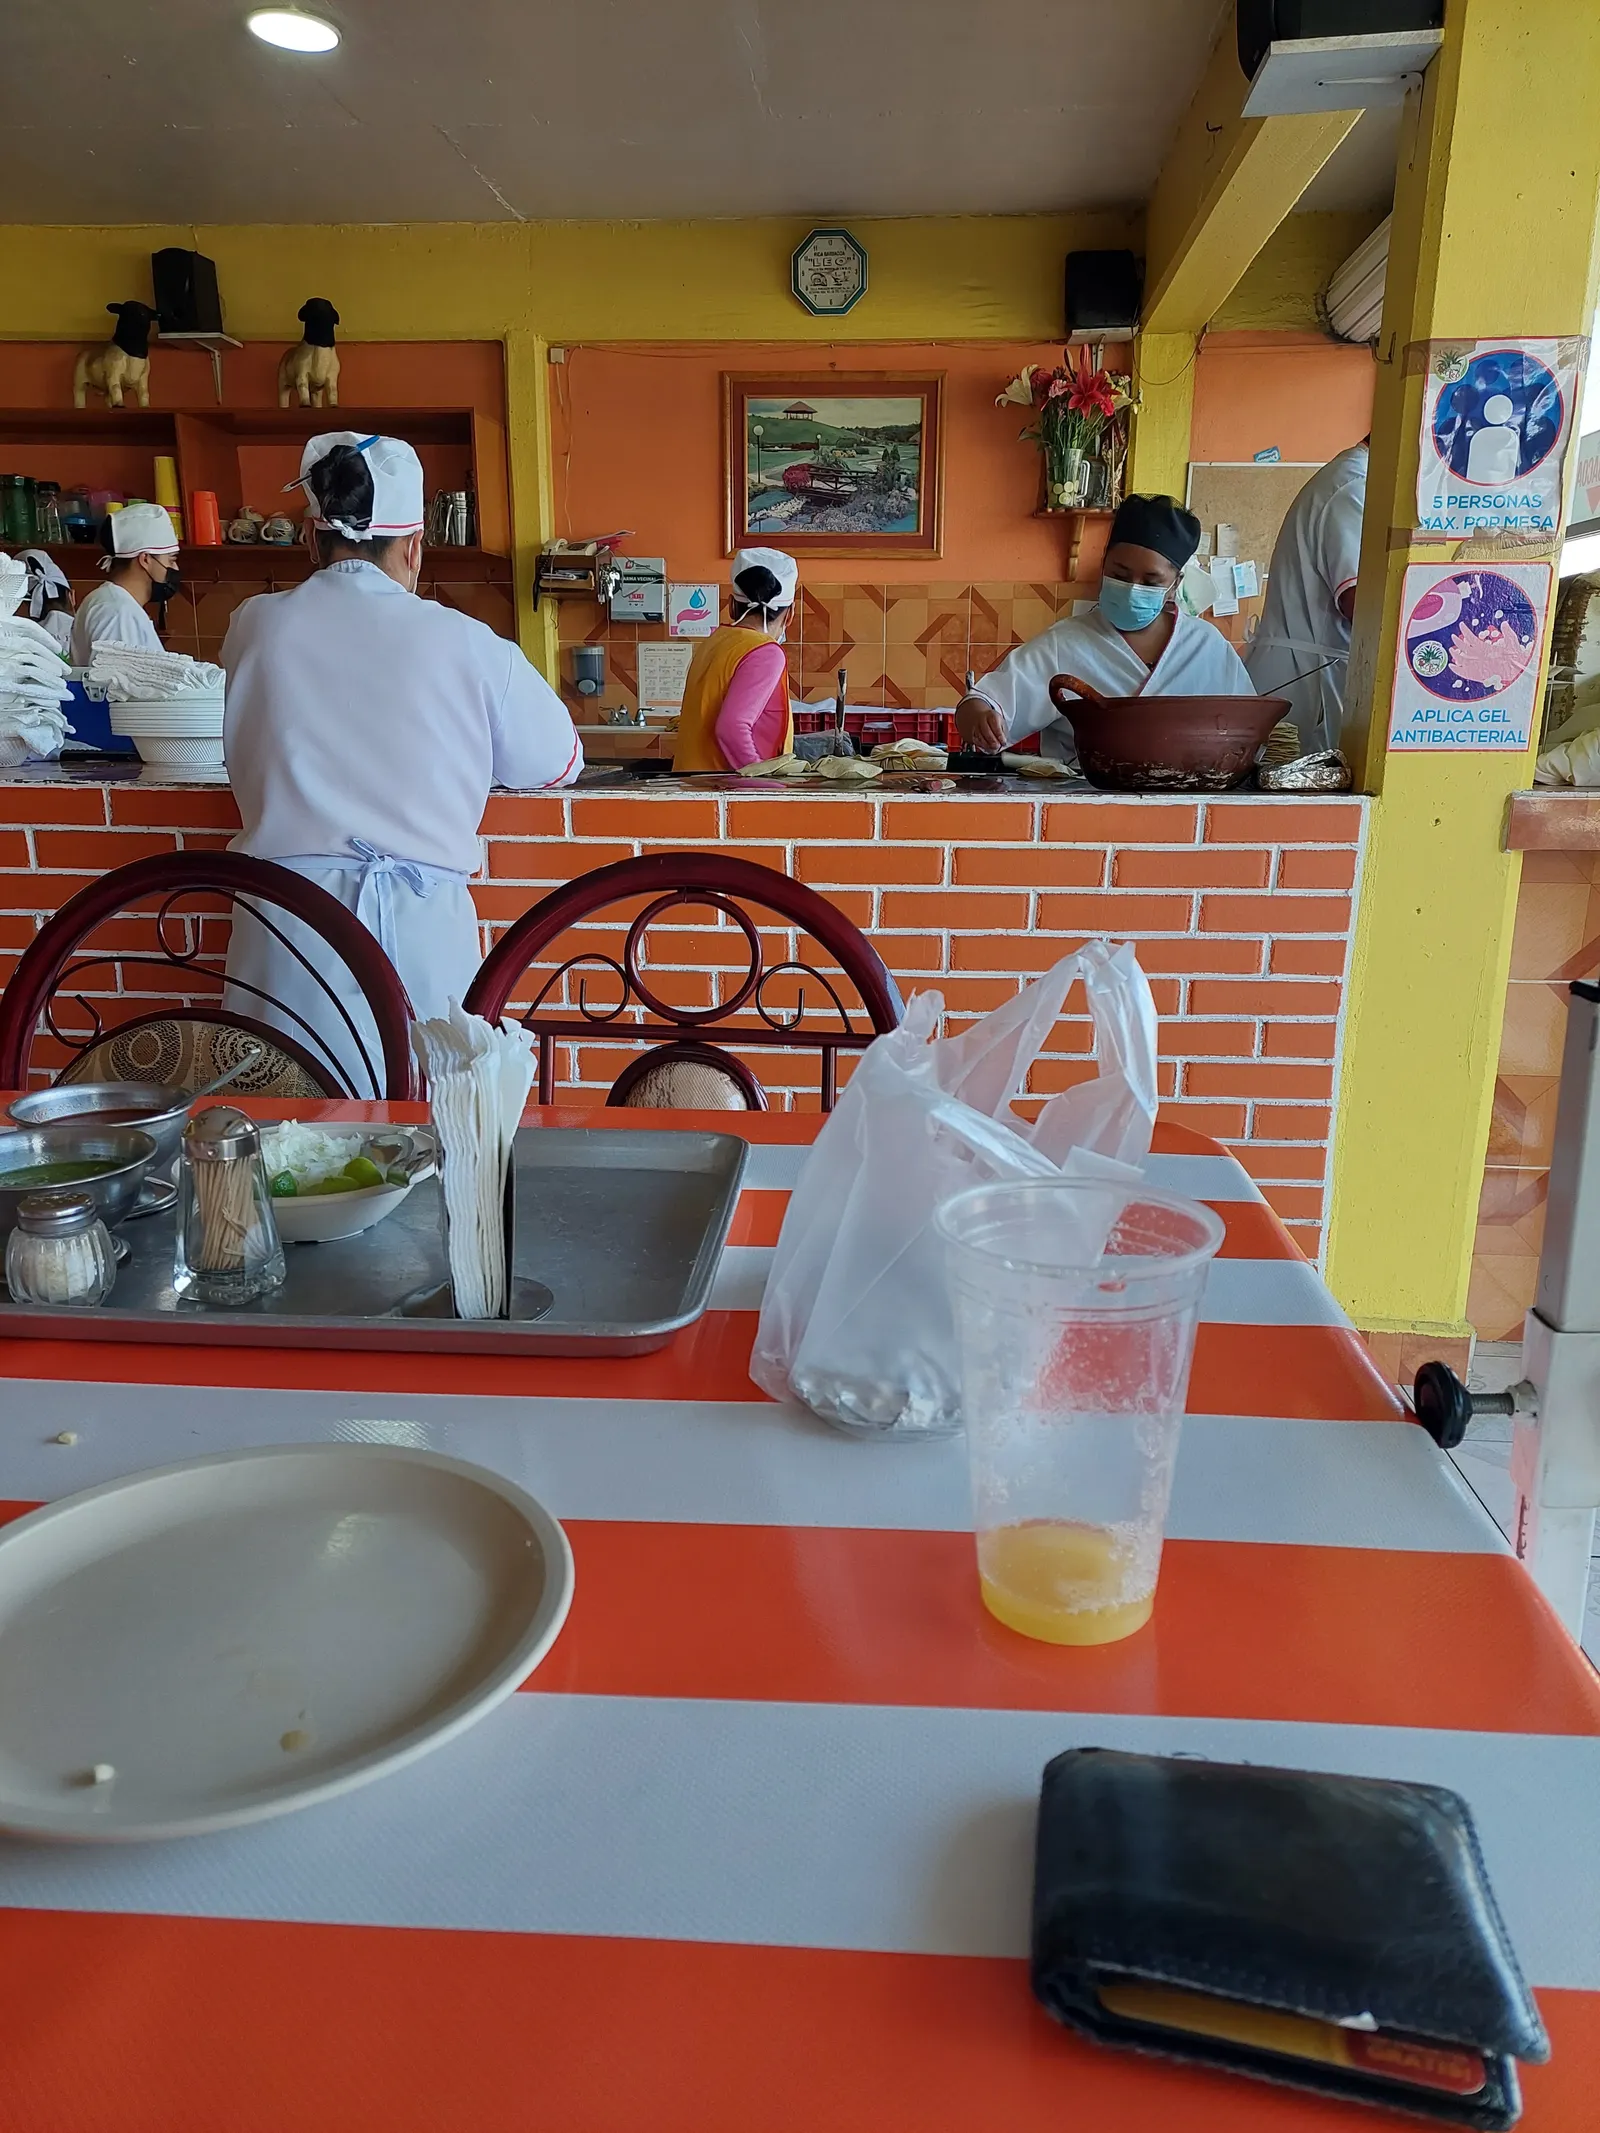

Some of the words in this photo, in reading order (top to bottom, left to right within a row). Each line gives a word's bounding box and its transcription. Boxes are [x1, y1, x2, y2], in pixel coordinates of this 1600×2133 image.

[1433, 496, 1443, 508] 5
[1446, 494, 1542, 509] PERSONAS
[1464, 515, 1500, 529] POR
[1504, 515, 1554, 529] MESA
[1411, 709, 1474, 723] APLICA
[1478, 709, 1511, 723] GEL
[1391, 729, 1527, 743] ANTIBACTERIAL
